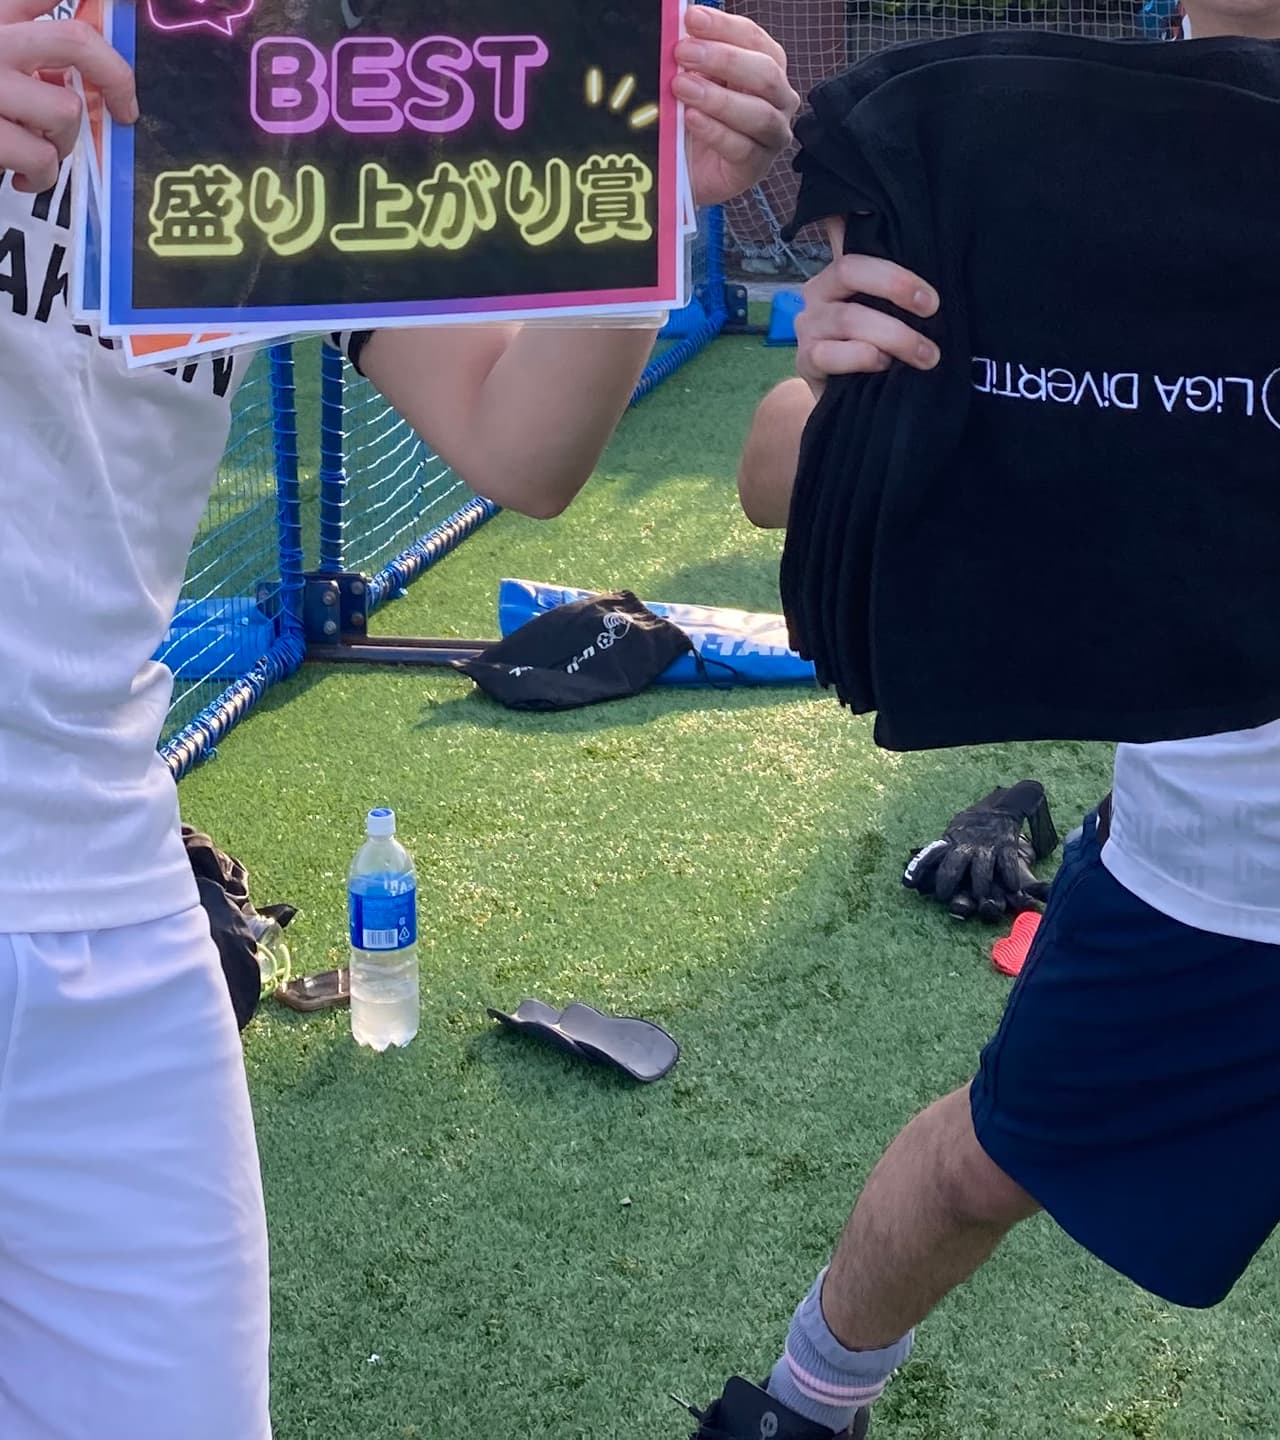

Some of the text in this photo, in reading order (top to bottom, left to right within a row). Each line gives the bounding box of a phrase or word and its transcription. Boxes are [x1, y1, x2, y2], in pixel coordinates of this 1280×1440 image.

[249, 35, 549, 135] BEST
[148, 153, 654, 257] 盛り上がり賞
